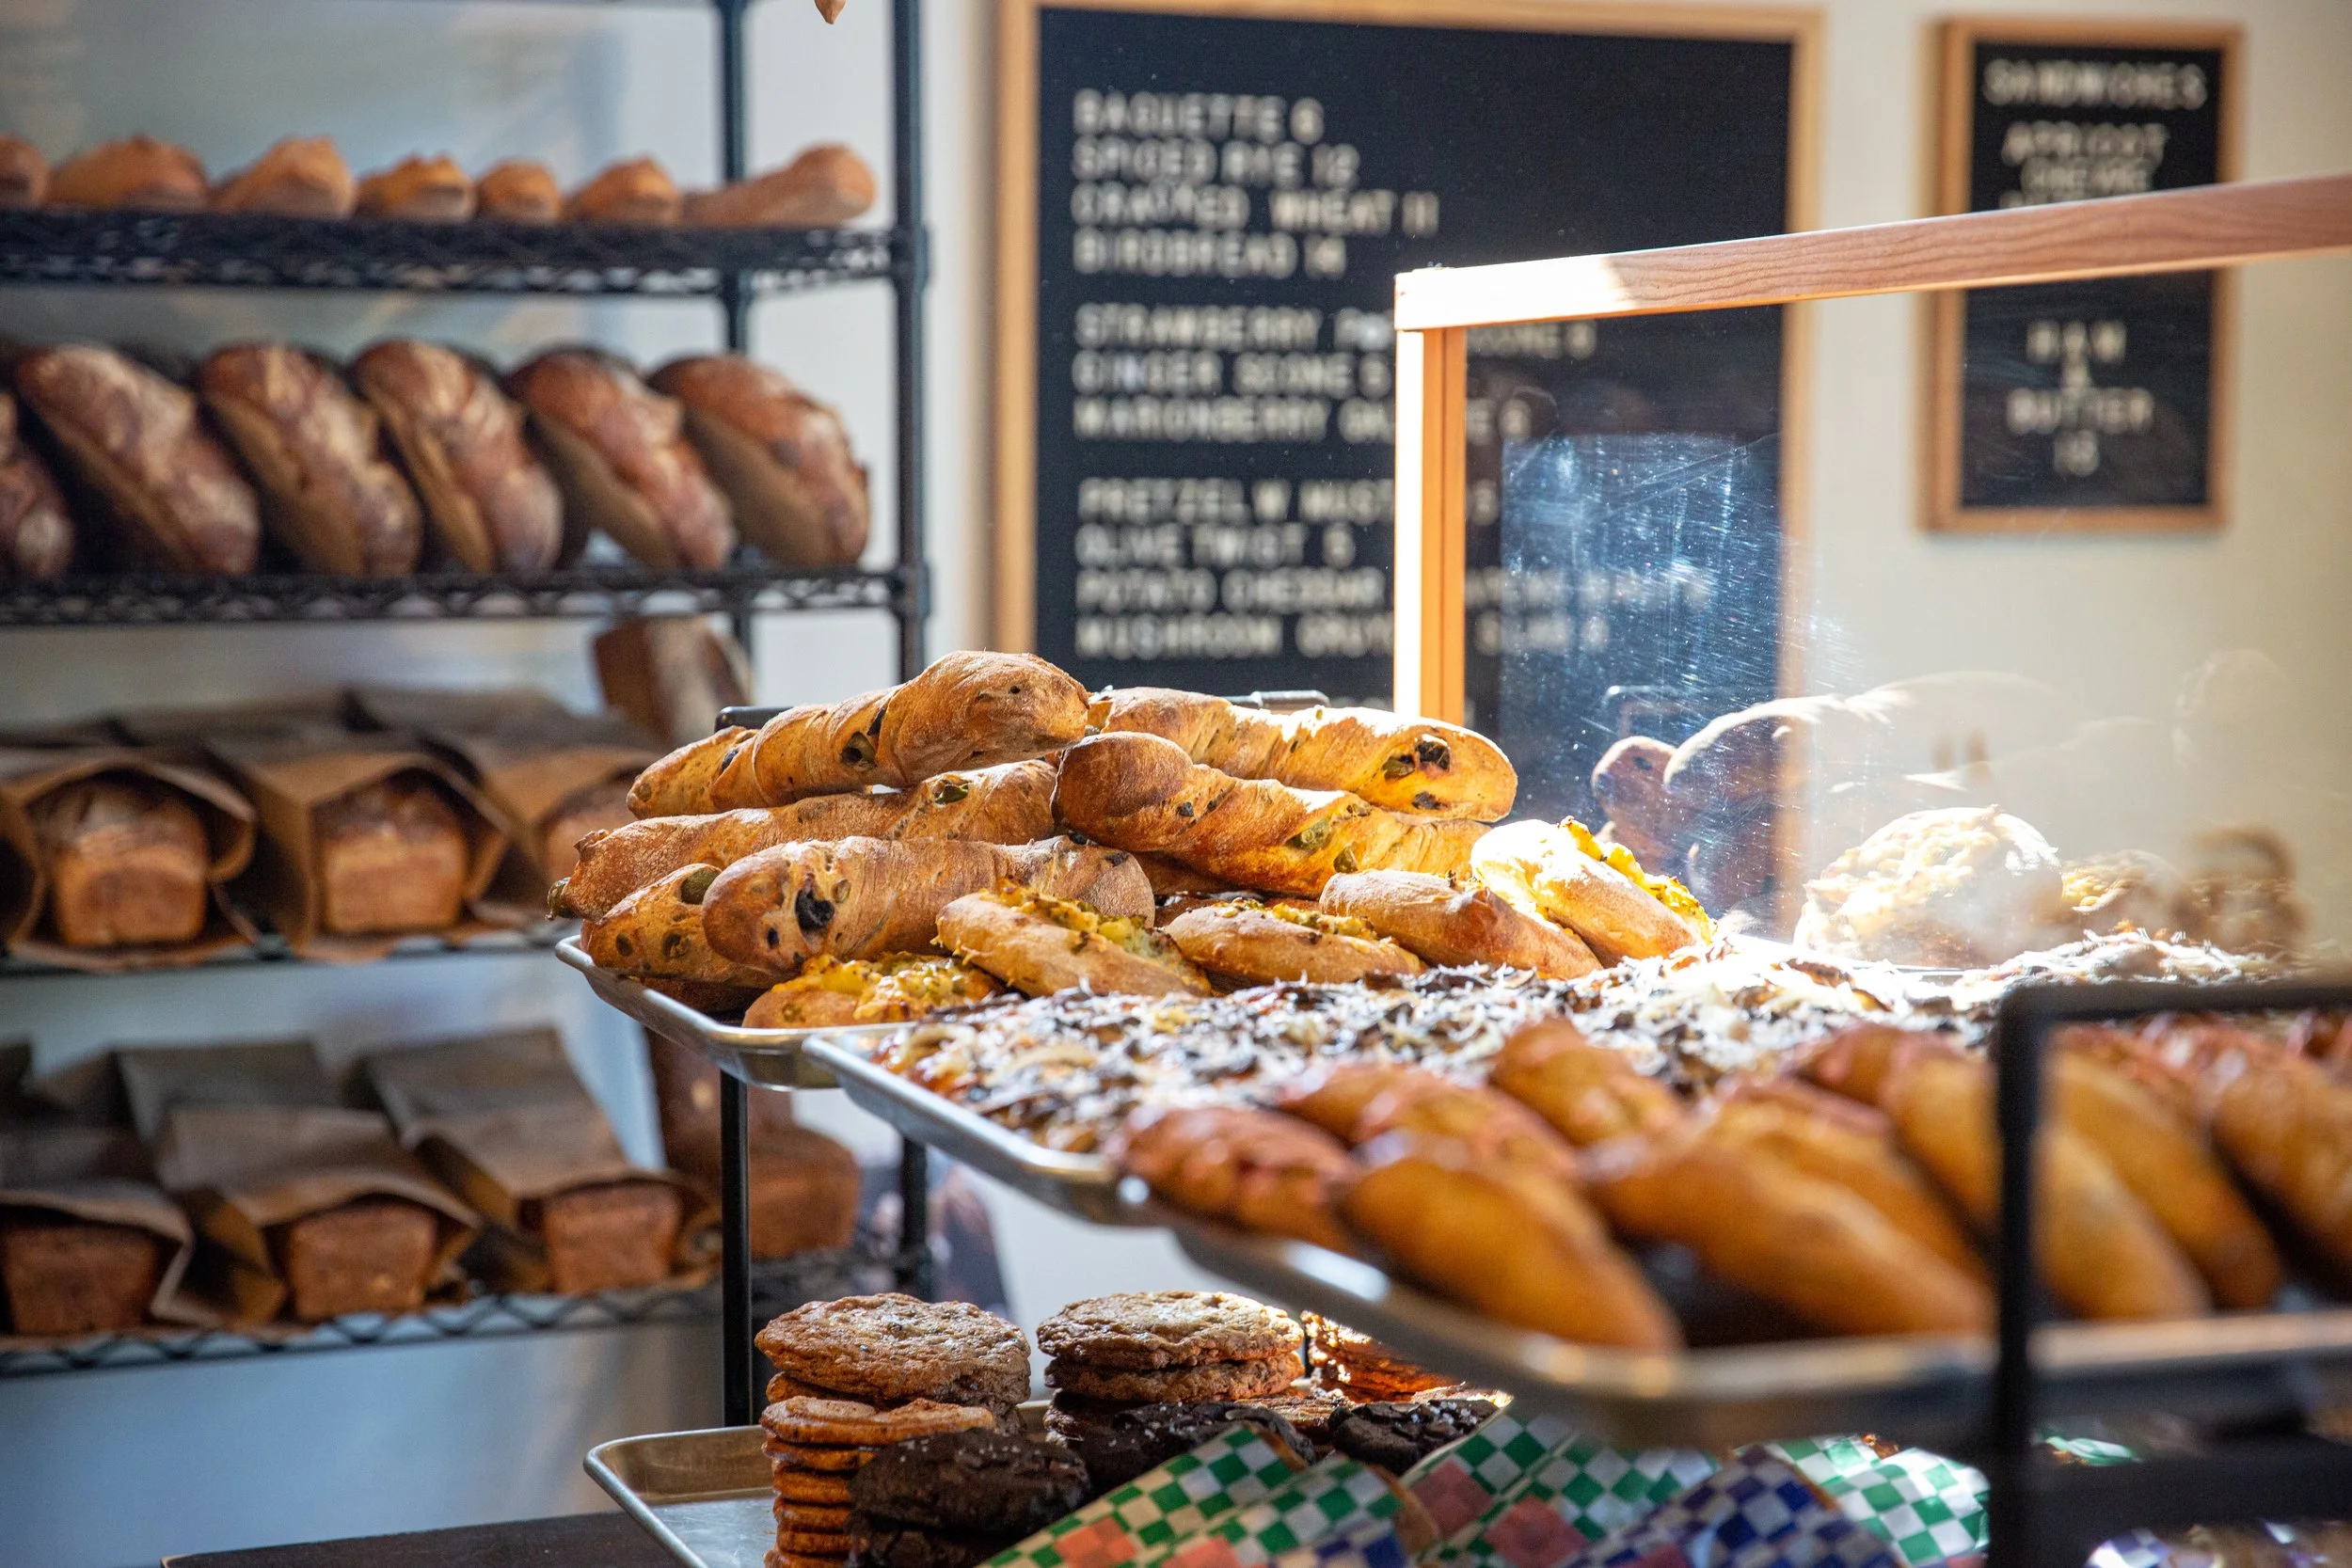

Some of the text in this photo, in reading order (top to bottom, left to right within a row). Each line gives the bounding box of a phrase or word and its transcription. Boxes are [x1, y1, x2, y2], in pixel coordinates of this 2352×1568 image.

[1984, 59, 2206, 110] SANDWICHES
[1074, 89, 1286, 142] BAGUETTE
[1073, 137, 1216, 183] SPICED
[1223, 141, 1304, 190] RYE
[1073, 178, 1248, 229] CRACKED
[1271, 189, 1394, 235] WHEAT
[1074, 229, 1296, 277] BIRDBREAD
[1076, 303, 1320, 352] STRAWBERRY
[1074, 351, 1221, 396] GINGER
[1234, 353, 1356, 401] SCONE
[1074, 397, 1327, 442] MARIONBERRY
[2008, 388, 2154, 434] BUTTER
[1078, 480, 1248, 522] PRETZEL
[1076, 525, 1184, 569] OLIVE
[1192, 524, 1308, 568] TWIST
[1076, 567, 1387, 614] POTATO CHEDDAR
[1075, 613, 1282, 658] MUSHROOM
